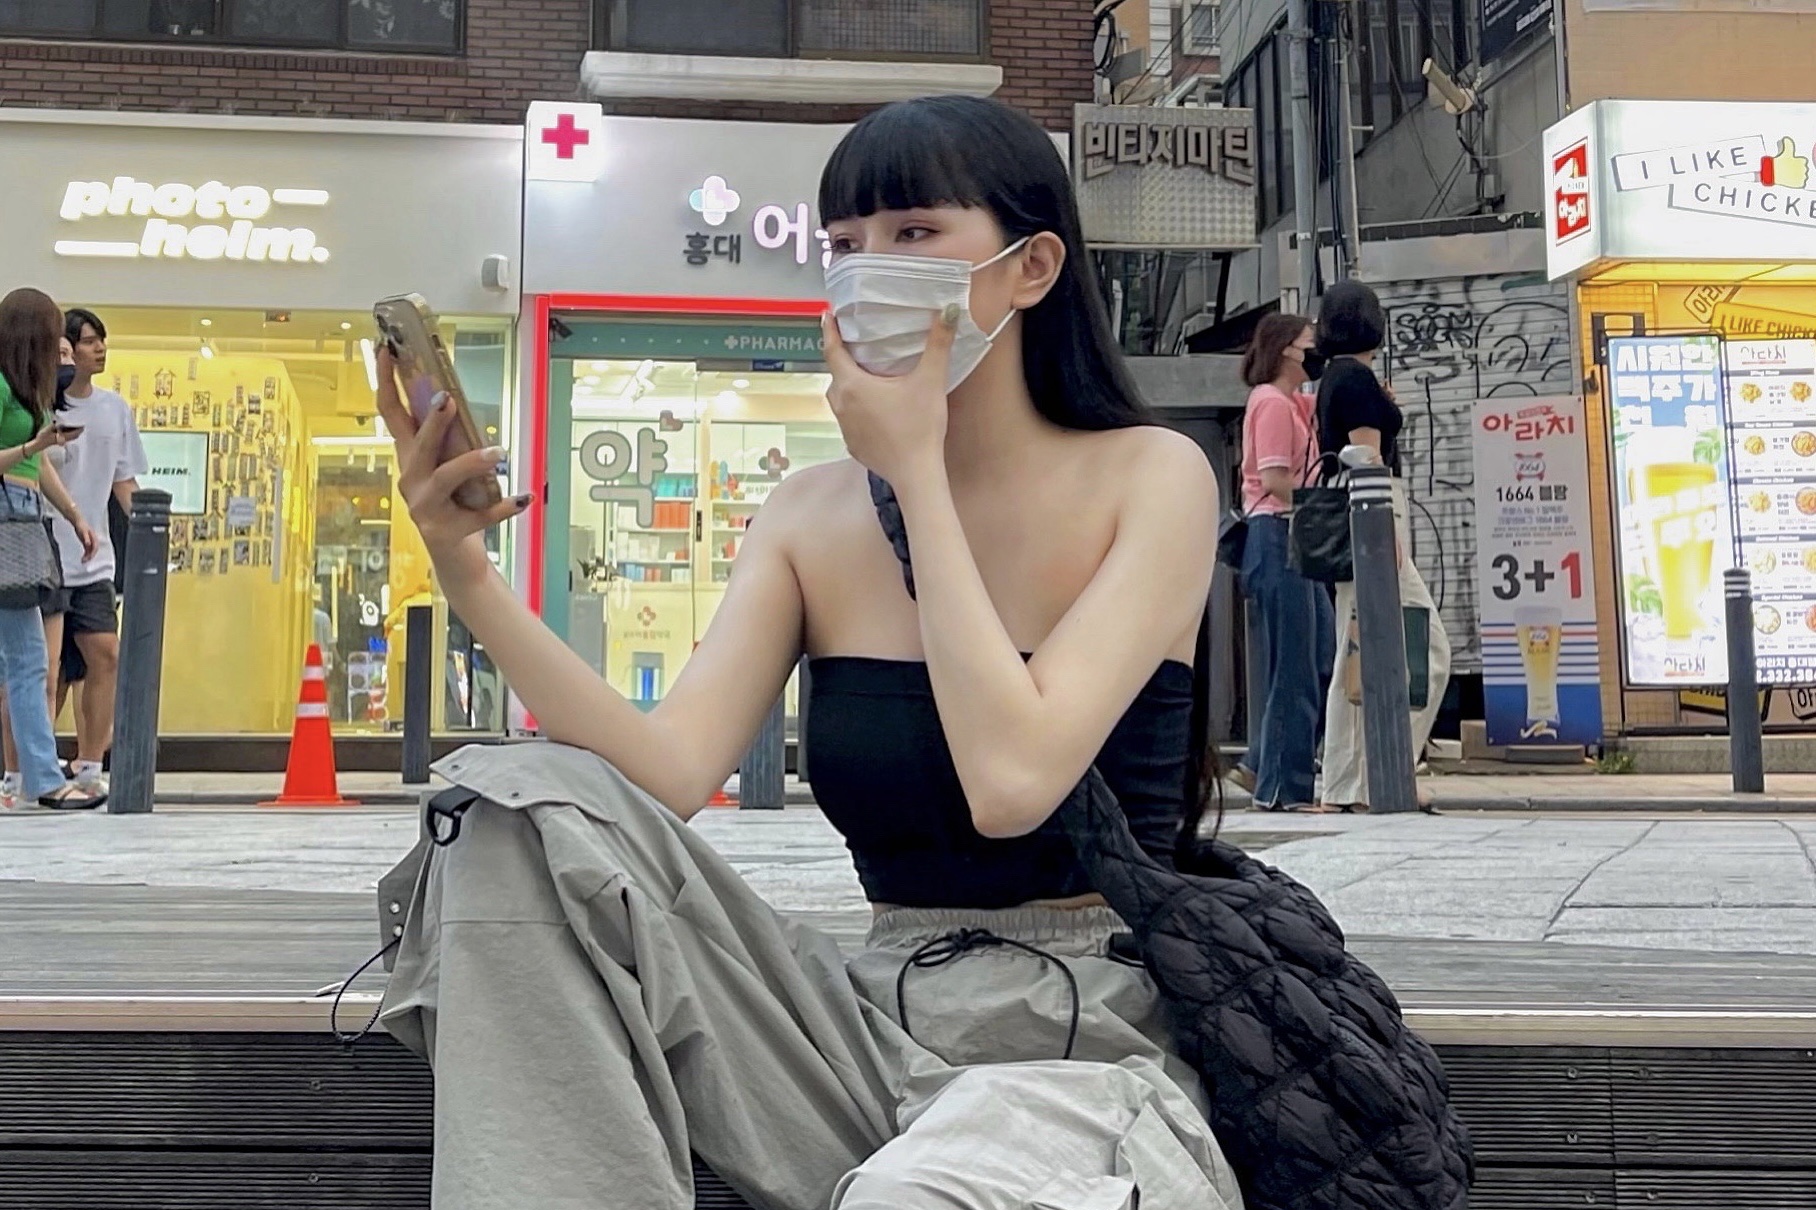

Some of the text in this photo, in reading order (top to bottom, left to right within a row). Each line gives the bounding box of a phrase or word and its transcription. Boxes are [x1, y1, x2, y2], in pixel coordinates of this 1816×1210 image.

[1641, 146, 1748, 180] I LIKE
[59, 176, 271, 221] photo
[683, 231, 741, 265] 홍대
[1482, 412, 1574, 441] 아라치
[579, 427, 668, 529] 약
[1496, 485, 1535, 503] 1664
[1491, 551, 1582, 601] 3+1
